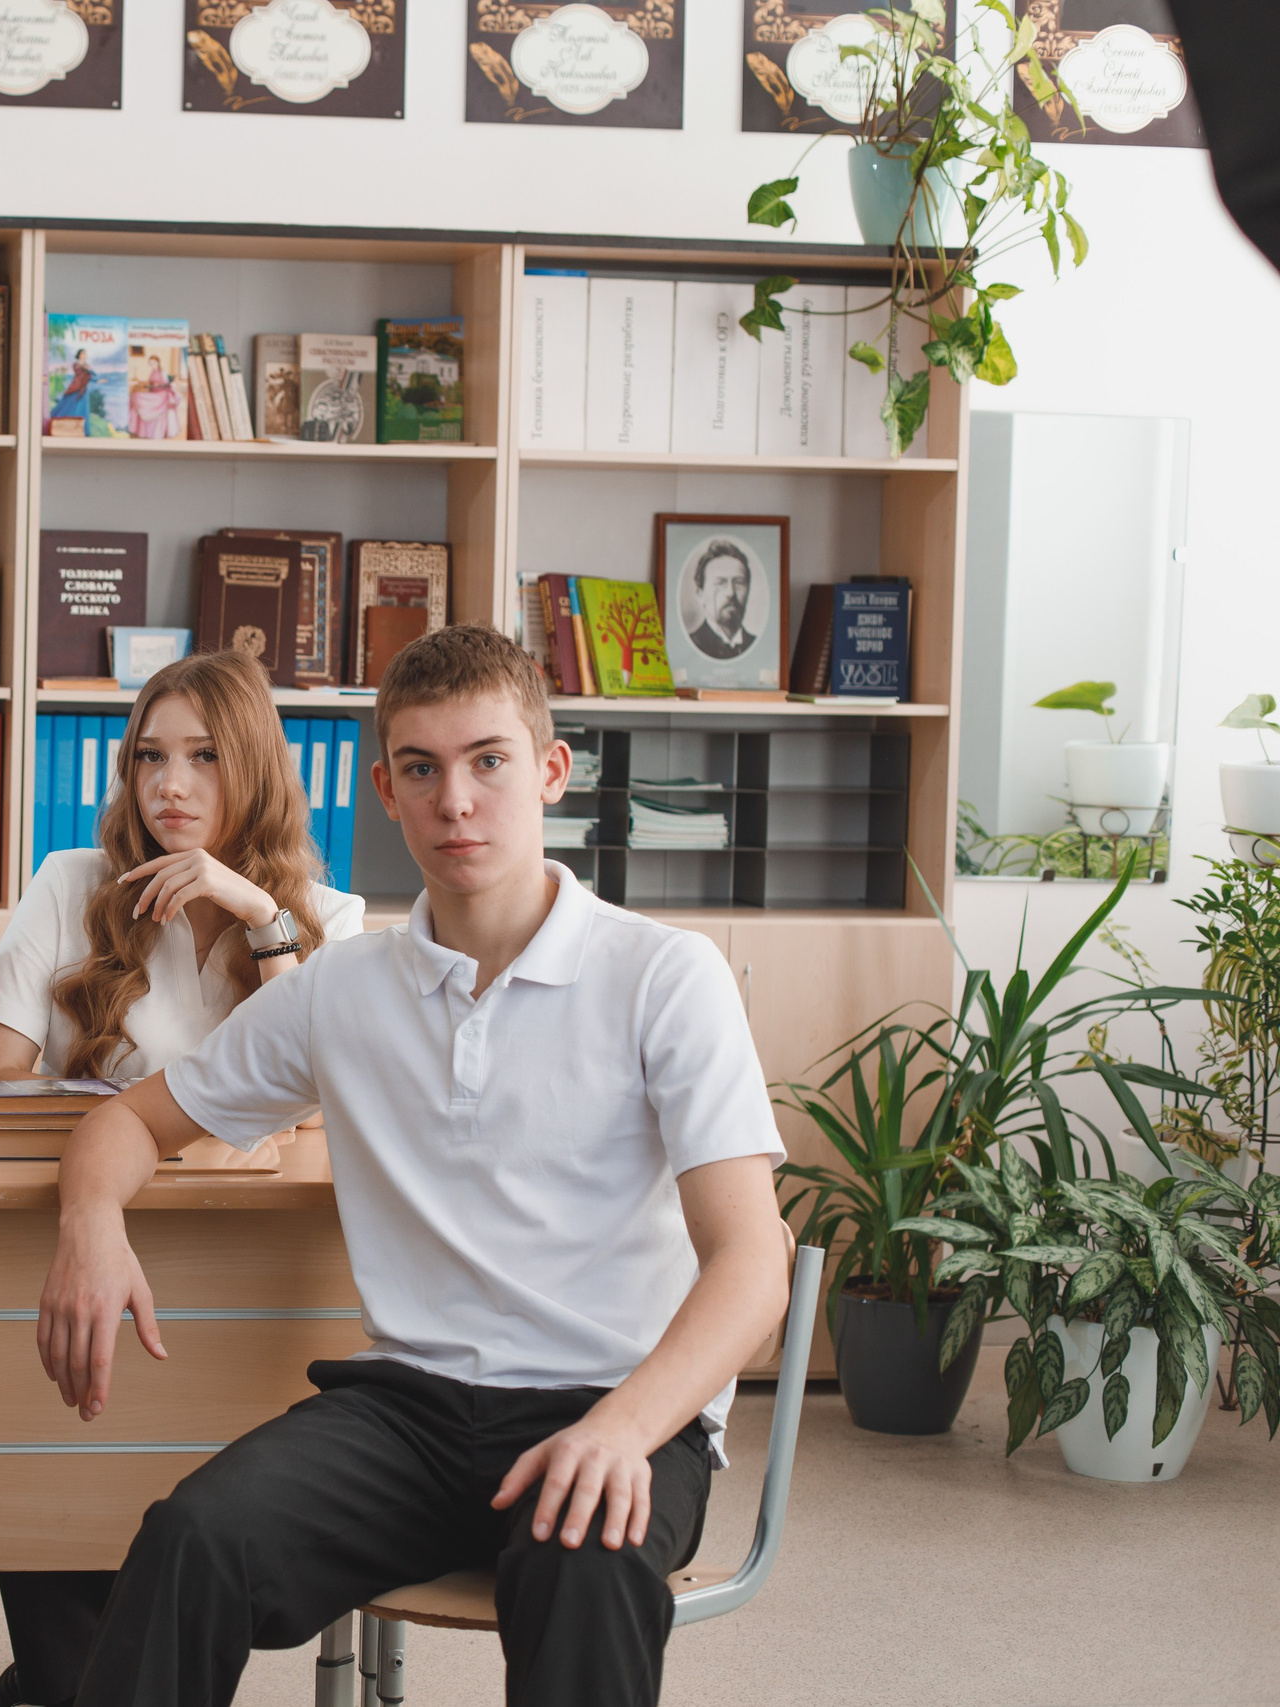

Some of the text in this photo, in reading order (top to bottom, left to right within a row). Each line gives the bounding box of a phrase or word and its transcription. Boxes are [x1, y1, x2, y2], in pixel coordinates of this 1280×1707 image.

[1101, 39, 1145, 58] Есенин
[1103, 60, 1141, 84] Сергей
[1073, 77, 1167, 102] Александрович
[79, 330, 115, 343] ГРОЗА
[717, 312, 729, 342] ОГЭ
[531, 297, 544, 440] Техника безопасности
[619, 297, 635, 444] Поурочные разработки
[713, 355, 727, 430] Подготовка
[780, 344, 794, 418] Документы
[801, 379, 813, 446] классному
[59, 568, 123, 580] ТОЛКОВЫЙ
[64, 580, 117, 592] СЛОВАРЬ
[60, 592, 121, 604] РУССКОГО
[70, 604, 110, 616] ЯЗЫКА
